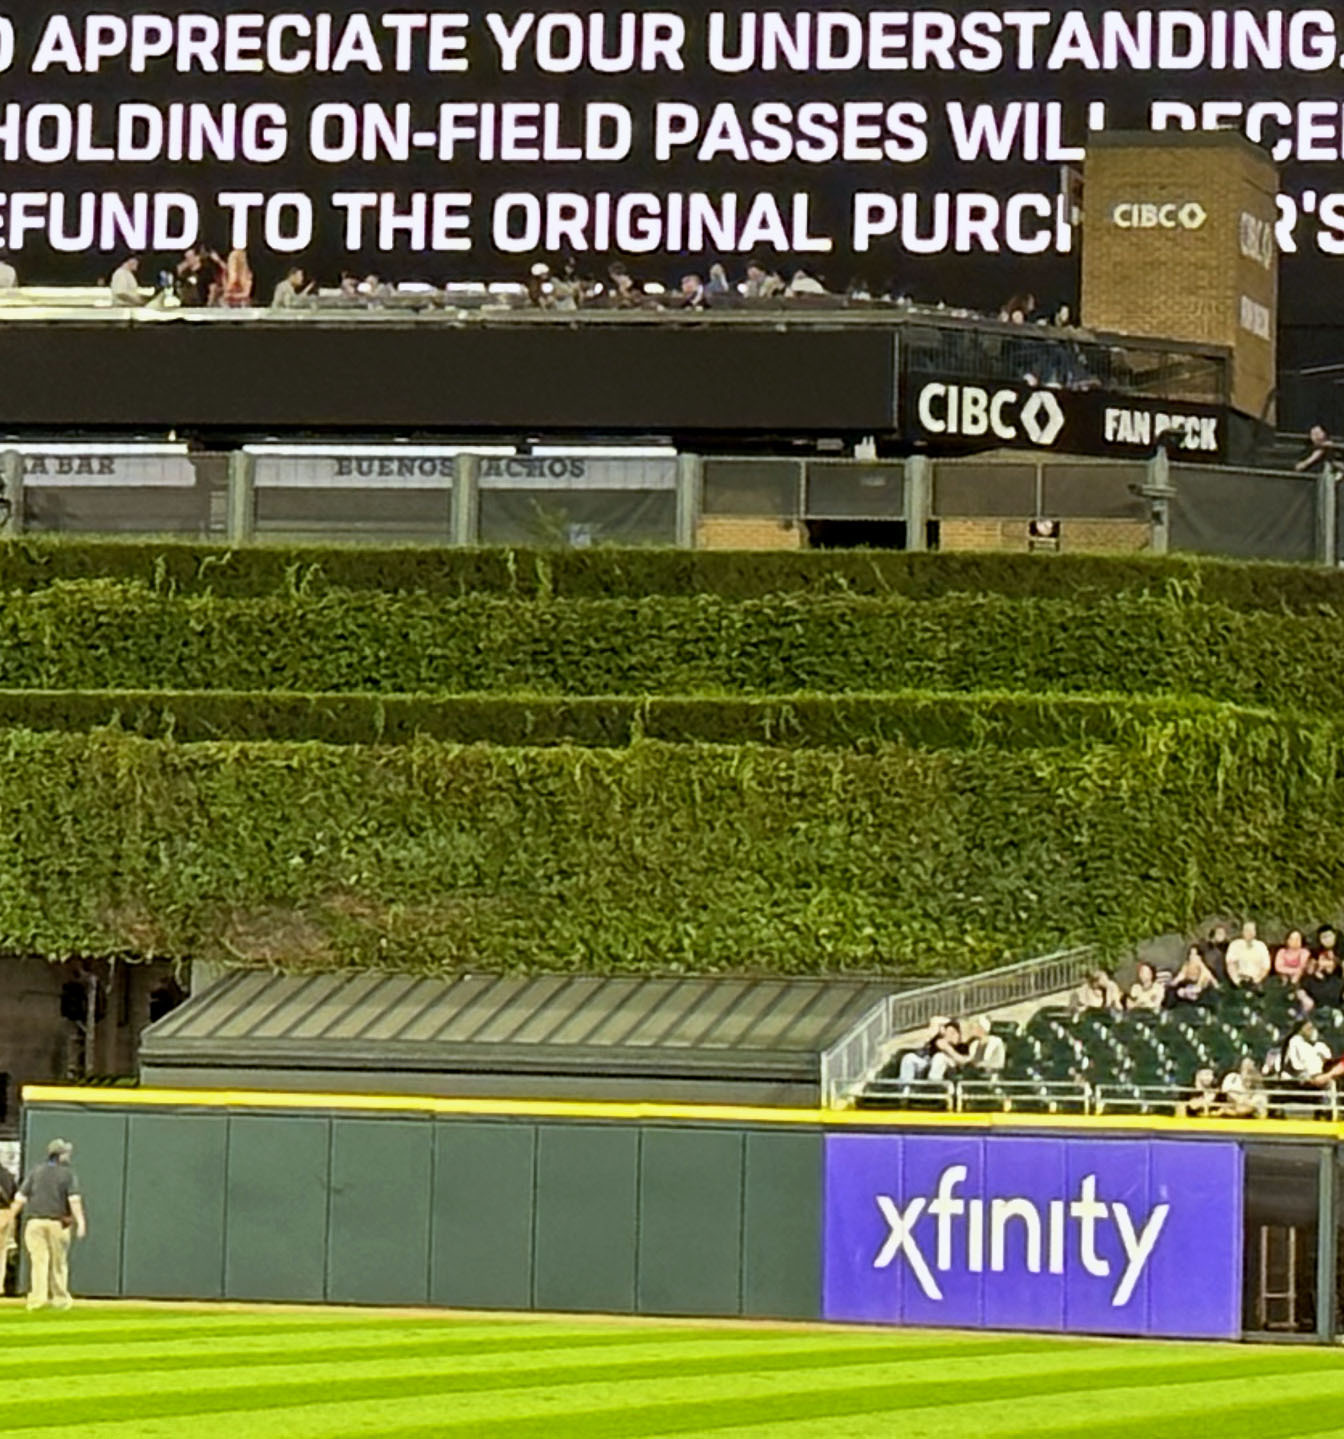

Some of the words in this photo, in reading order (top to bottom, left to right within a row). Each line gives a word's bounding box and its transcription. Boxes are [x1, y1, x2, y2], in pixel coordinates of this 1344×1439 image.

[31, 13, 469, 73] APPRECIATE
[486, 12, 686, 73] YOUR
[310, 102, 632, 163] ON-FIELD
[655, 101, 928, 163] PASSES
[218, 192, 313, 251] TO
[332, 192, 472, 251] THE
[493, 192, 832, 253] ORIGINAL
[1113, 203, 1177, 228] CIBC
[918, 382, 1018, 440] CIBC
[1105, 408, 1151, 446] FAN
[55, 456, 115, 476] BAR
[477, 457, 585, 479] ACHOS
[873, 1165, 1170, 1307] xfinity
